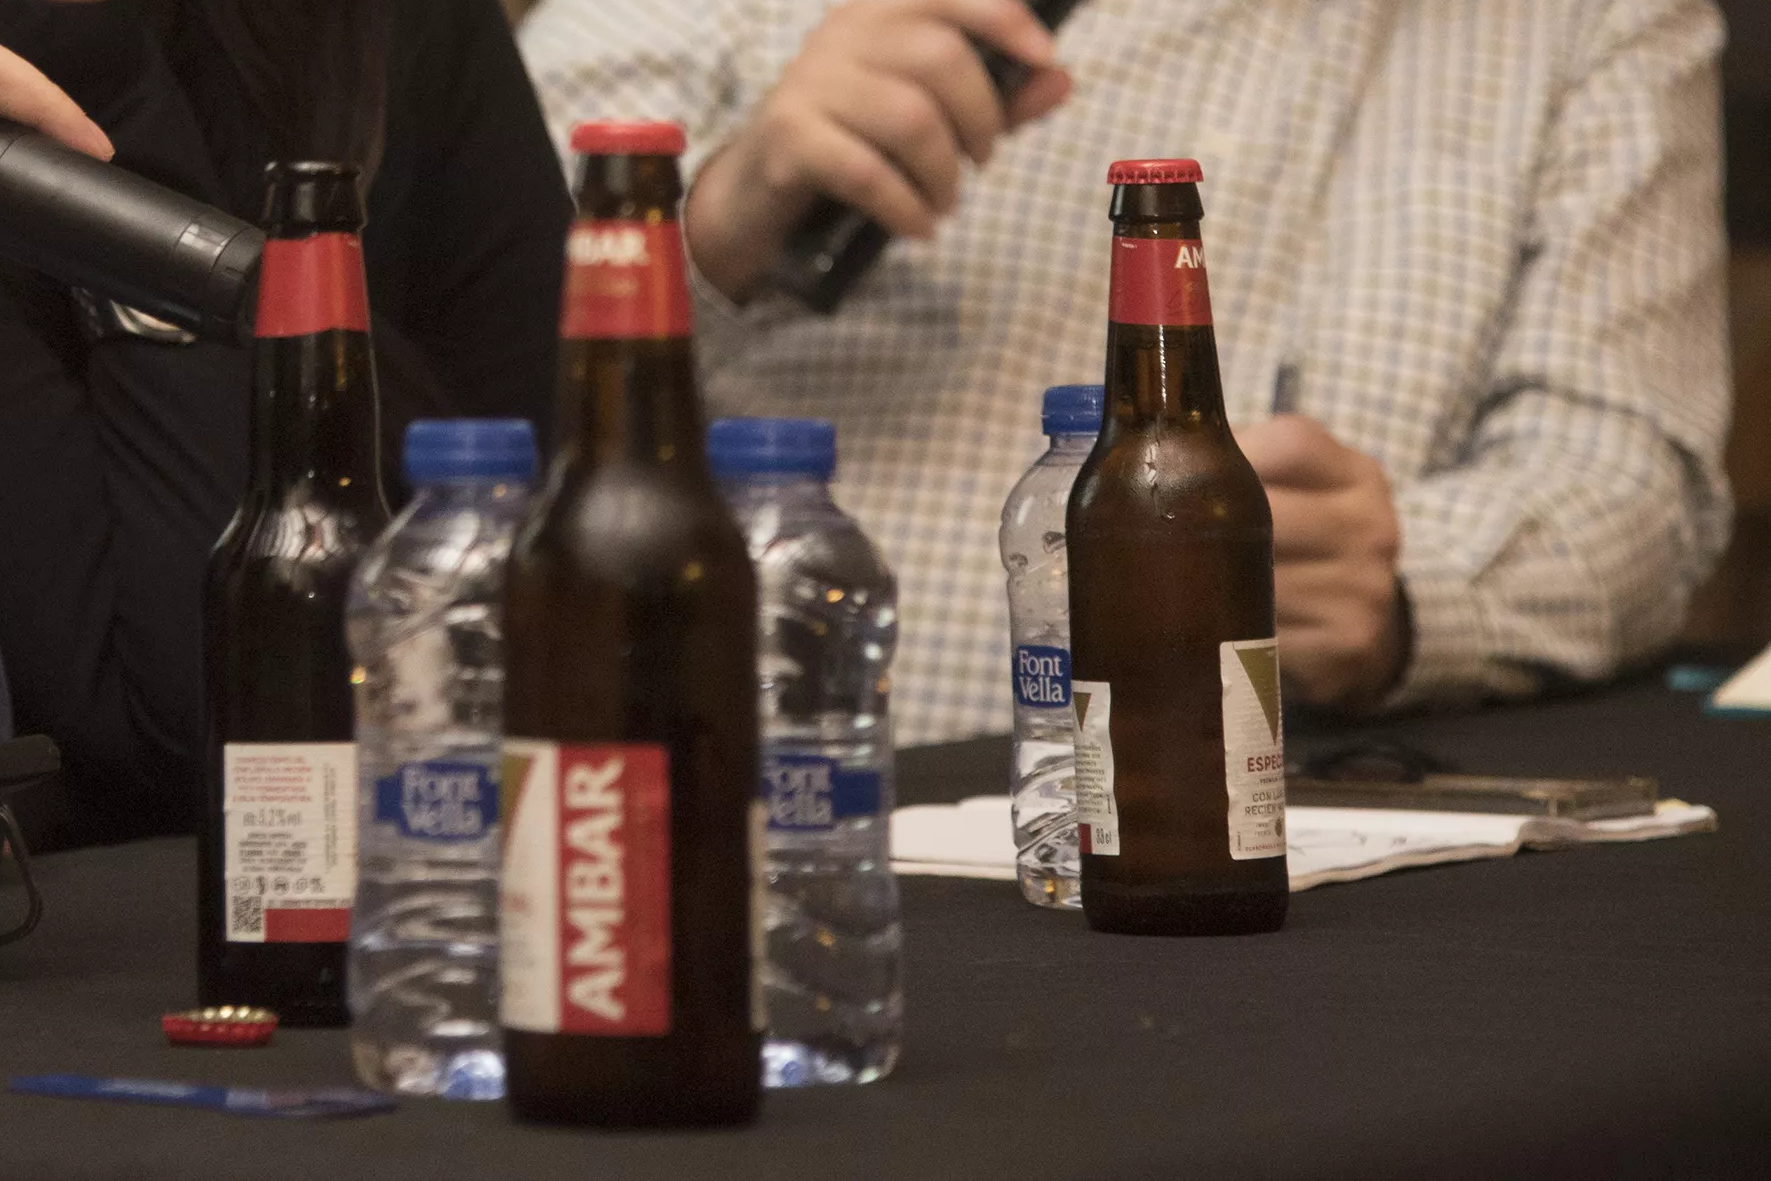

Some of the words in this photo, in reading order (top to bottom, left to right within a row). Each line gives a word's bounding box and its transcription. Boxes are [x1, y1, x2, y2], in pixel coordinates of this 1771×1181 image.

[1018, 650, 1064, 677] Font
[1018, 676, 1066, 703] Vella
[564, 755, 627, 1021] AMBAR
